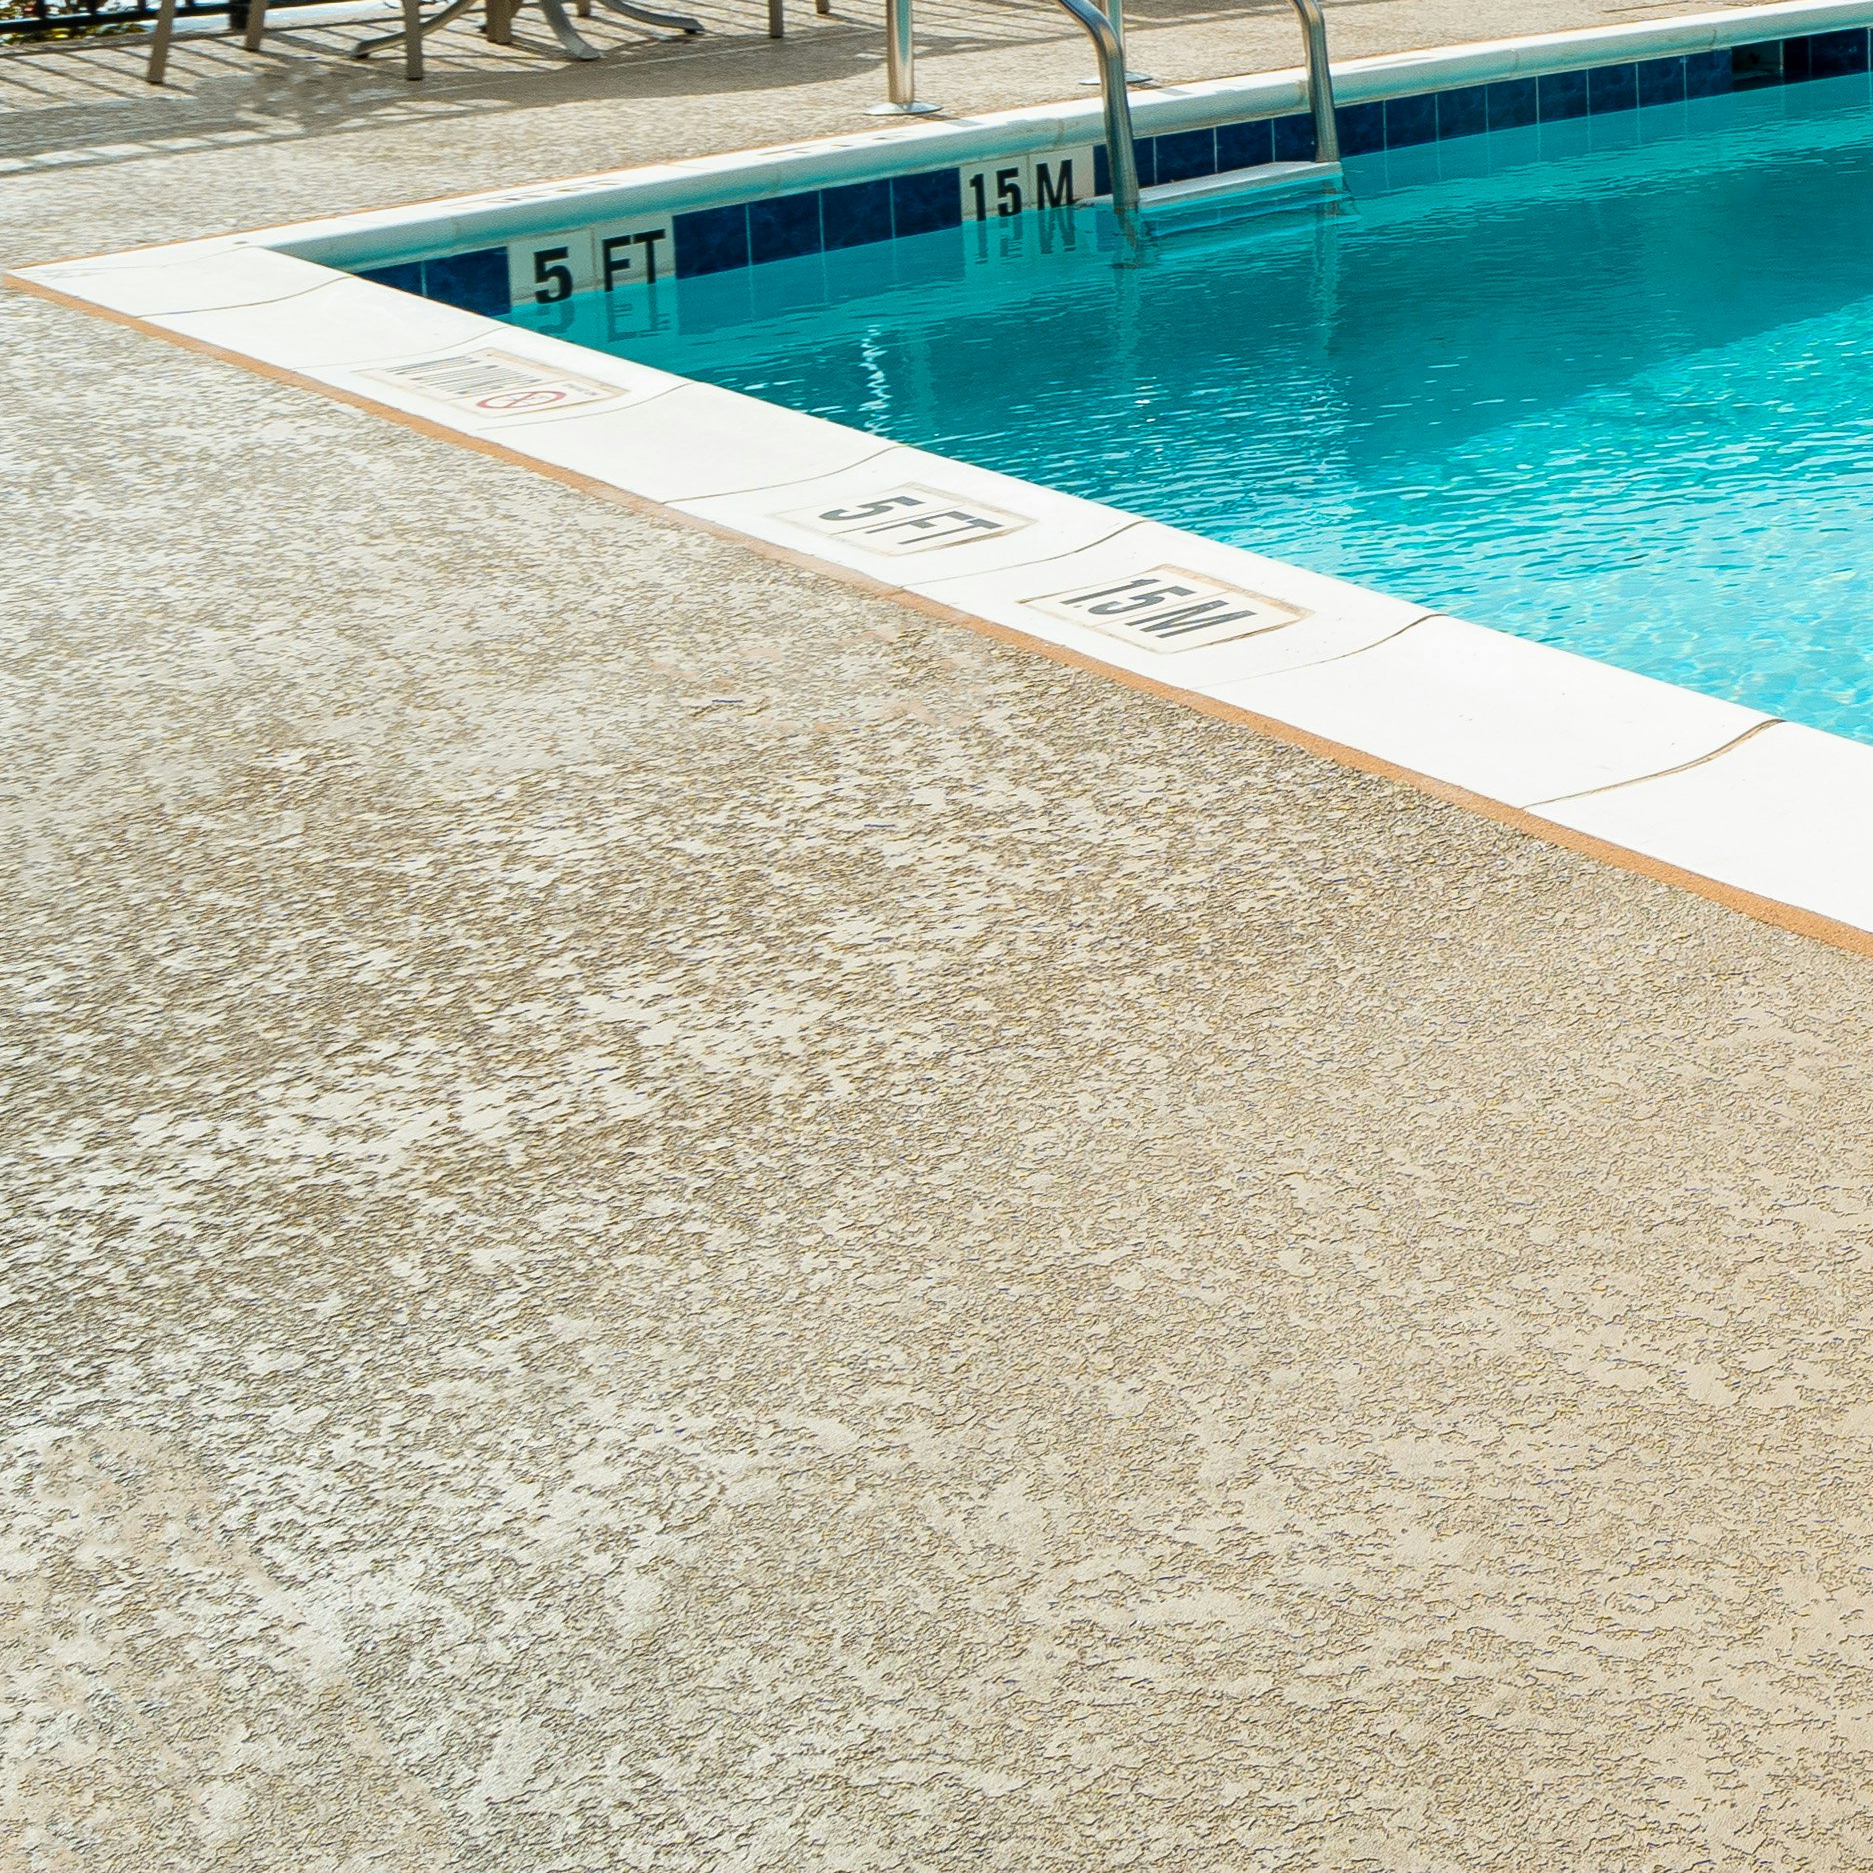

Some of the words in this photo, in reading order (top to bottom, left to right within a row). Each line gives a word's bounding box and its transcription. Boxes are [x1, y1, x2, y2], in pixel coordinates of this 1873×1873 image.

[534, 246, 574, 305] 5
[602, 228, 667, 292] FT
[819, 496, 924, 521] 5
[863, 510, 1005, 545] FT
